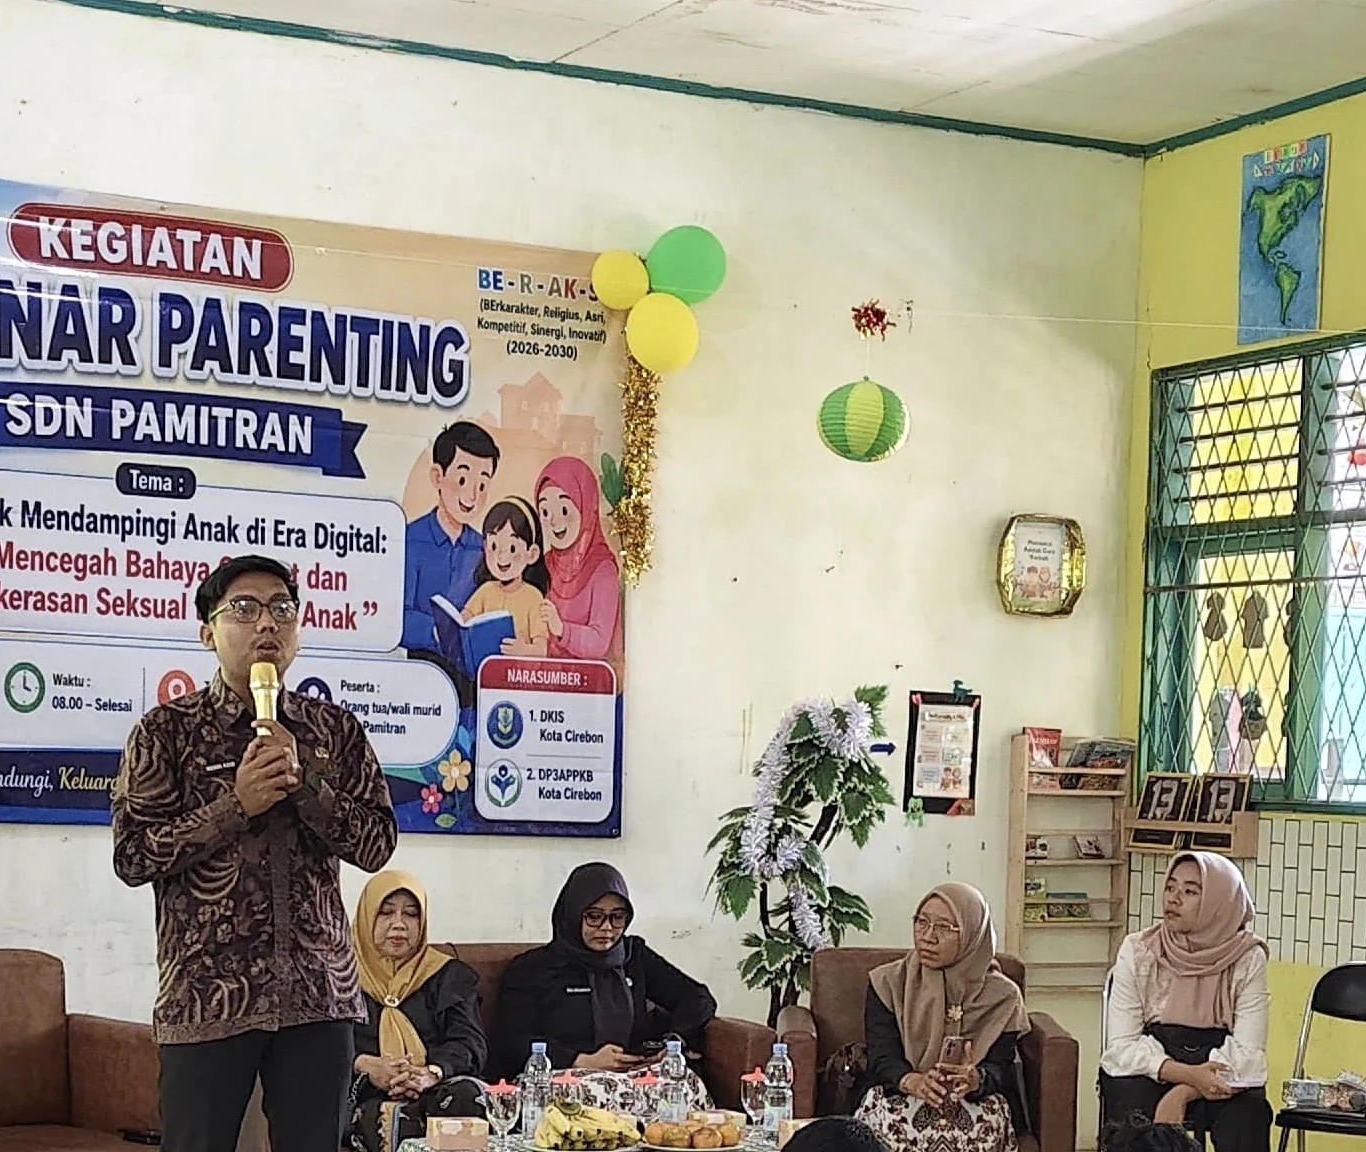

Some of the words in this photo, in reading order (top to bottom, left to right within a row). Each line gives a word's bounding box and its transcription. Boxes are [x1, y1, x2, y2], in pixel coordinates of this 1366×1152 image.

[37, 215, 263, 280] KEGIATAN
[478, 268, 504, 291] BE
[480, 298, 541, 318] (BErkarakter,
[543, 306, 582, 323] Religius,
[585, 309, 606, 326] Asri,
[477, 318, 528, 336] Kompetitif,
[530, 325, 567, 341] Sinergi,
[568, 328, 607, 345] Inovatif)
[158, 298, 467, 398] PARENTING
[506, 340, 578, 361] (2026-2030)
[5, 393, 93, 438] SDN
[111, 398, 313, 455] PAMITRAN
[130, 468, 174, 493] Tema
[21, 500, 177, 545] Mendampingi
[183, 513, 240, 544] Anak
[246, 517, 266, 546] di
[273, 520, 307, 549] Era
[314, 522, 387, 558] Digital:
[126, 549, 210, 588] Bahaya
[307, 563, 348, 592] dan
[96, 587, 187, 620] Seksual
[301, 601, 358, 630] Anak
[52, 673, 84, 688] Waktu
[340, 679, 375, 693] Peserta
[507, 669, 581, 686] NARASUMBER
[52, 696, 83, 710] 08.00
[94, 698, 133, 712] Selesai
[340, 700, 370, 716] Orang
[372, 702, 411, 715] tua/wali
[413, 704, 441, 716] murid
[529, 709, 537, 722] 1.
[540, 710, 565, 723] DKIS
[363, 720, 406, 734] Pamitran
[540, 729, 562, 742] Kota
[565, 730, 604, 743] Cirebon
[58, 766, 121, 799] Keluarg
[526, 768, 536, 780] 2.
[539, 768, 594, 783] DP3APPKB
[538, 787, 561, 800] Kota
[564, 787, 602, 801] Cirebon
